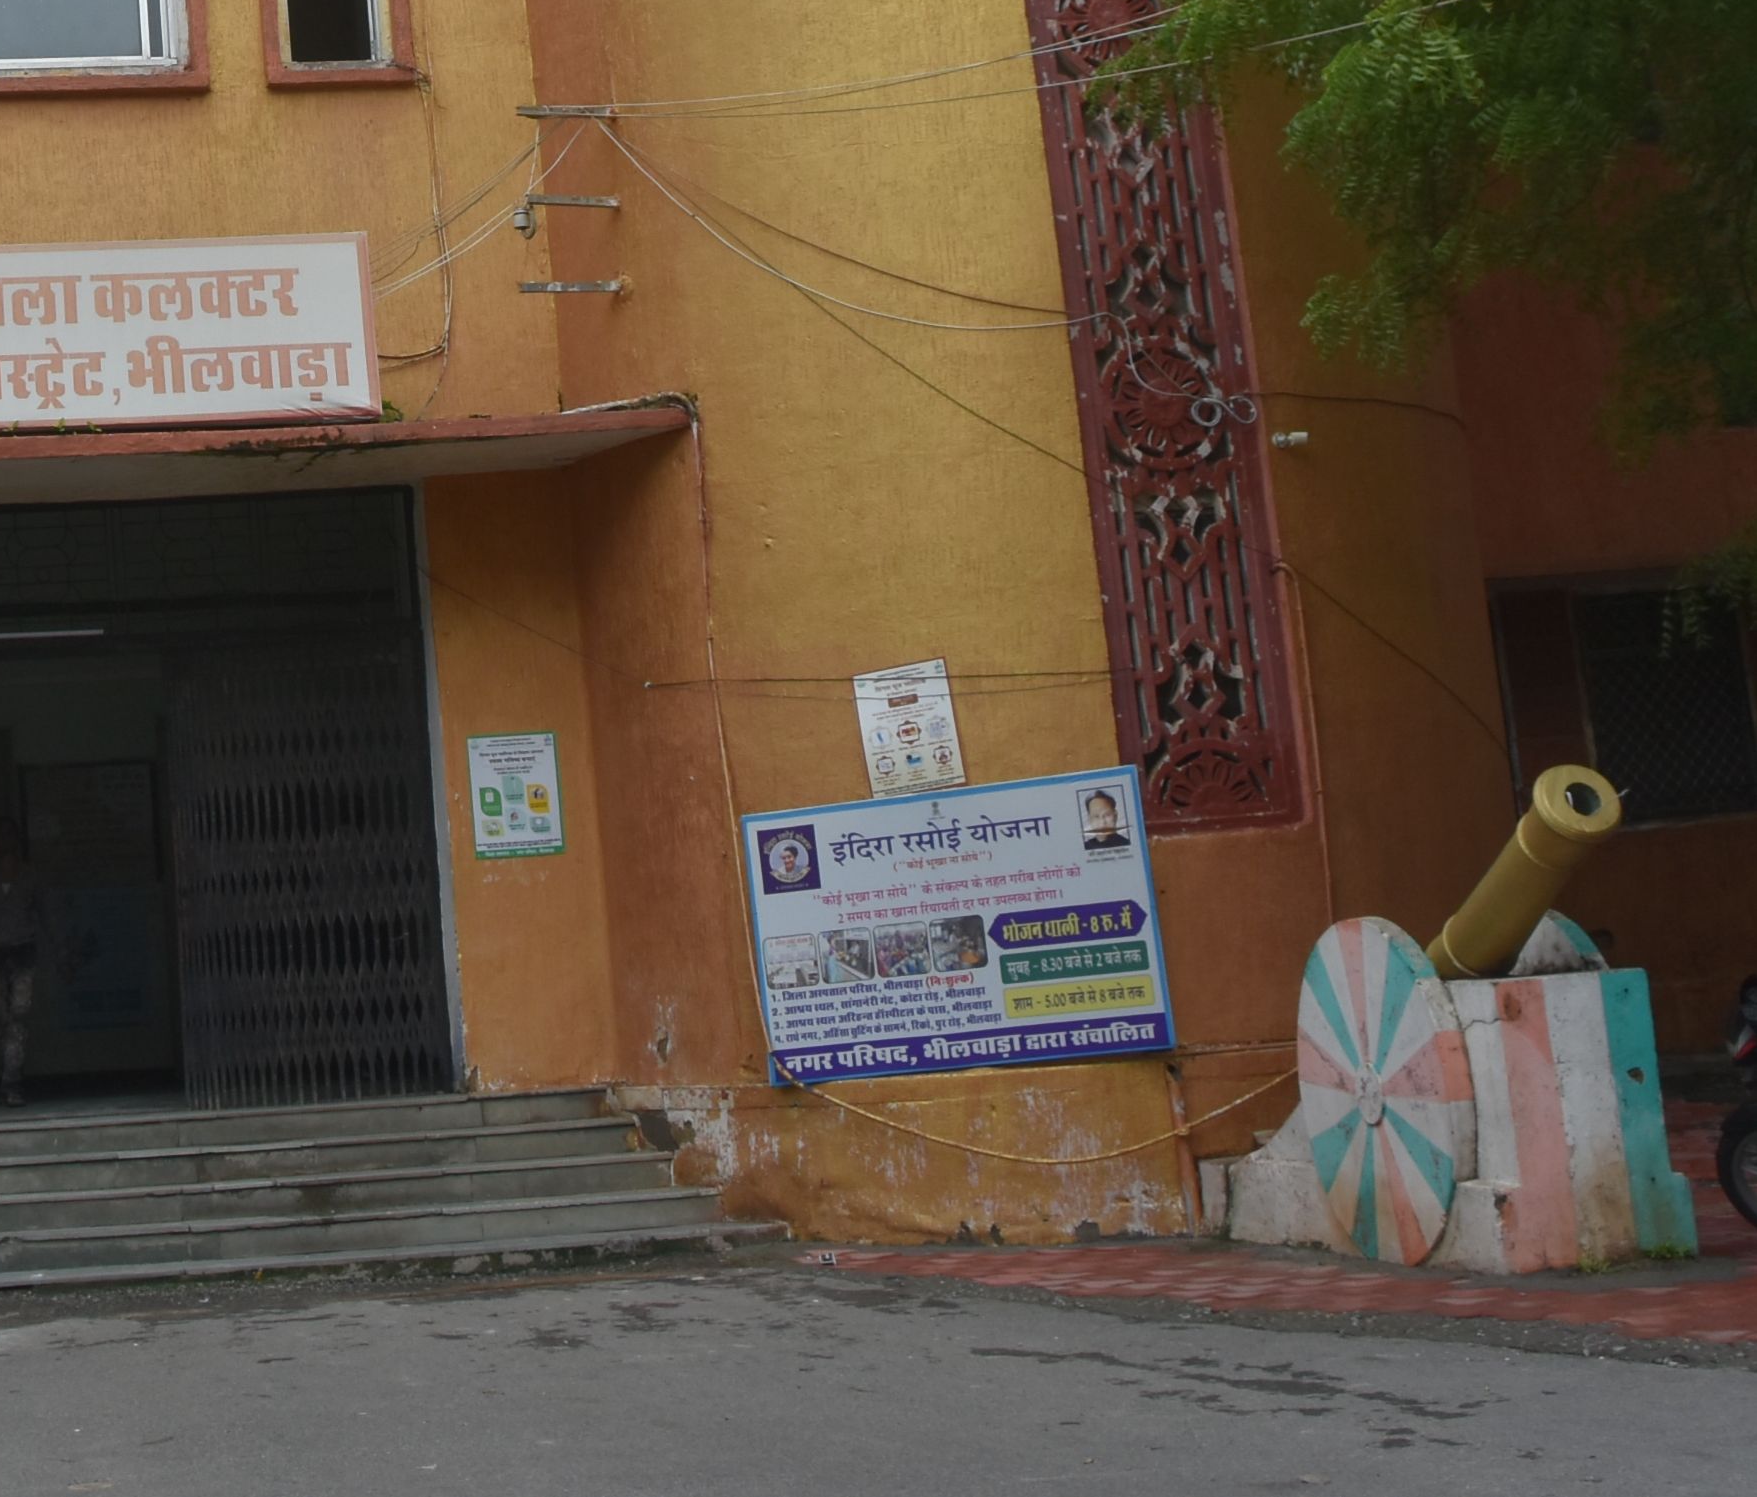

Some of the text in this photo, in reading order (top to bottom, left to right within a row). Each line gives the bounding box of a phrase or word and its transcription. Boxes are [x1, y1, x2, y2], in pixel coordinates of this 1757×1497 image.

[90, 268, 299, 322] कलक्टर
[127, 336, 352, 402] भीलवाड़ा
[829, 815, 1051, 866] इंदिरा रसोई योजना
[845, 891, 870, 906] भूखा
[871, 890, 884, 899] ना
[921, 880, 932, 894] के
[934, 879, 968, 892] संकल्प
[970, 875, 982, 888] के
[984, 875, 1007, 886] तहत
[1008, 869, 1034, 883] गरीब
[1036, 865, 1063, 880] लोगों
[1065, 863, 1080, 877] को
[838, 913, 844, 924] 2
[846, 910, 871, 921] समय
[873, 908, 888, 918] का
[889, 905, 917, 918] खाना
[920, 897, 960, 914] रियायती
[961, 899, 975, 910] दर
[977, 897, 990, 906] पर
[992, 892, 1032, 905] उपलब्ध
[1002, 919, 1043, 942] भोजन
[1044, 912, 1080, 937] थाली
[1090, 916, 1099, 933] 8
[1120, 905, 1132, 929] में
[1006, 960, 1030, 981] सुबह
[1041, 956, 1063, 972] 8.30
[1063, 950, 1082, 968] बजे
[1082, 948, 1093, 967] से
[1095, 953, 1103, 967] 2
[1103, 946, 1122, 964] बजे
[1122, 949, 1142, 962] तक
[782, 990, 807, 1001] जिला
[809, 986, 847, 998] अस्पताल
[883, 979, 923, 990] भीलवाड़ा
[784, 1004, 812, 1015] आश्रय
[900, 992, 922, 1003] कोटा
[945, 986, 985, 1003] भीलवाड़ा
[1012, 997, 1033, 1010] शाम
[1045, 993, 1067, 1008] 5.00
[1067, 986, 1085, 1004] बजे
[1086, 985, 1096, 1002] से
[1099, 989, 1106, 1003] 8
[1107, 982, 1125, 1000] बजे
[1126, 986, 1145, 999] तक
[786, 1018, 814, 1029] आश्रय
[916, 1005, 926, 1015] के
[952, 1000, 992, 1015] भीलवाड़ा
[874, 1023, 882, 1033] के
[784, 1021, 1155, 1075] नगर परिषद, भीलवाड़ा द्वारा संचालित
